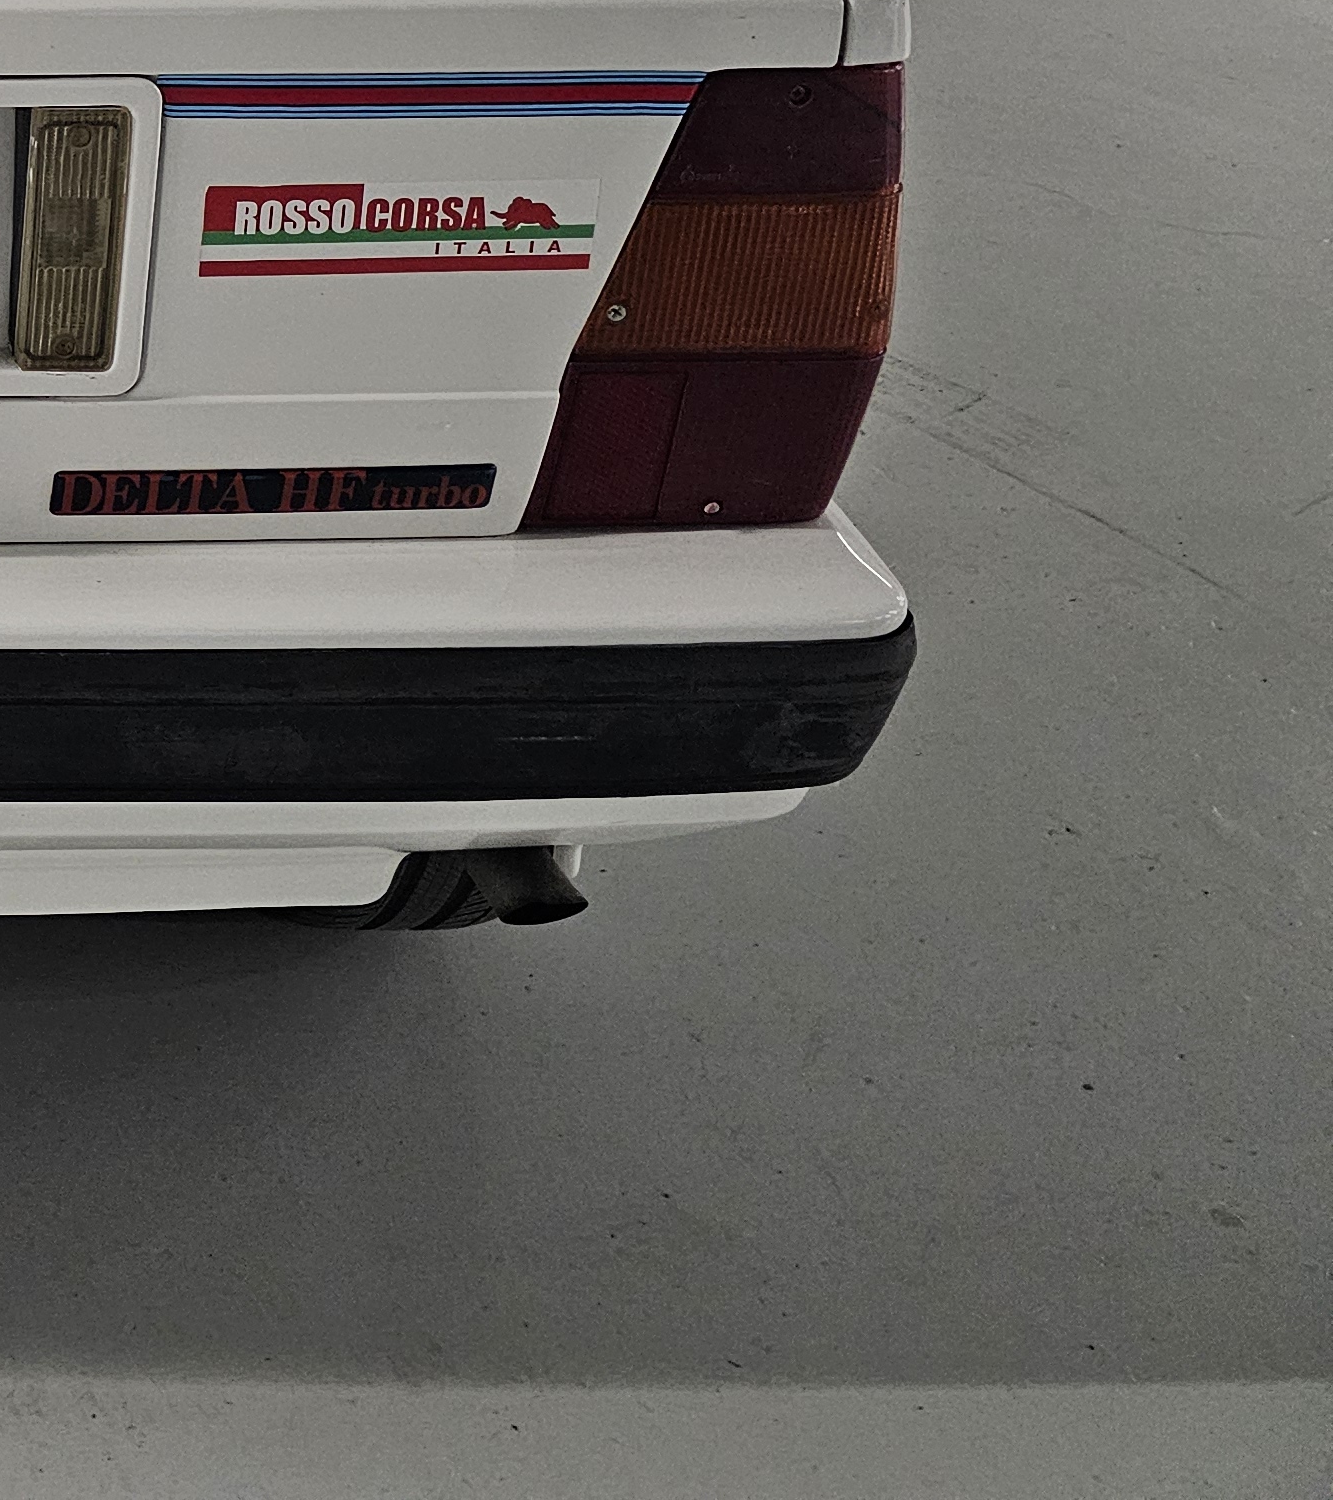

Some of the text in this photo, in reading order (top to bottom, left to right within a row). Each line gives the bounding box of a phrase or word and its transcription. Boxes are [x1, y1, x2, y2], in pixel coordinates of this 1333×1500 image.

[234, 196, 486, 236] ROSSO CORSA
[434, 239, 562, 255] ITALIA
[58, 469, 488, 514] DELTA HF turbo
